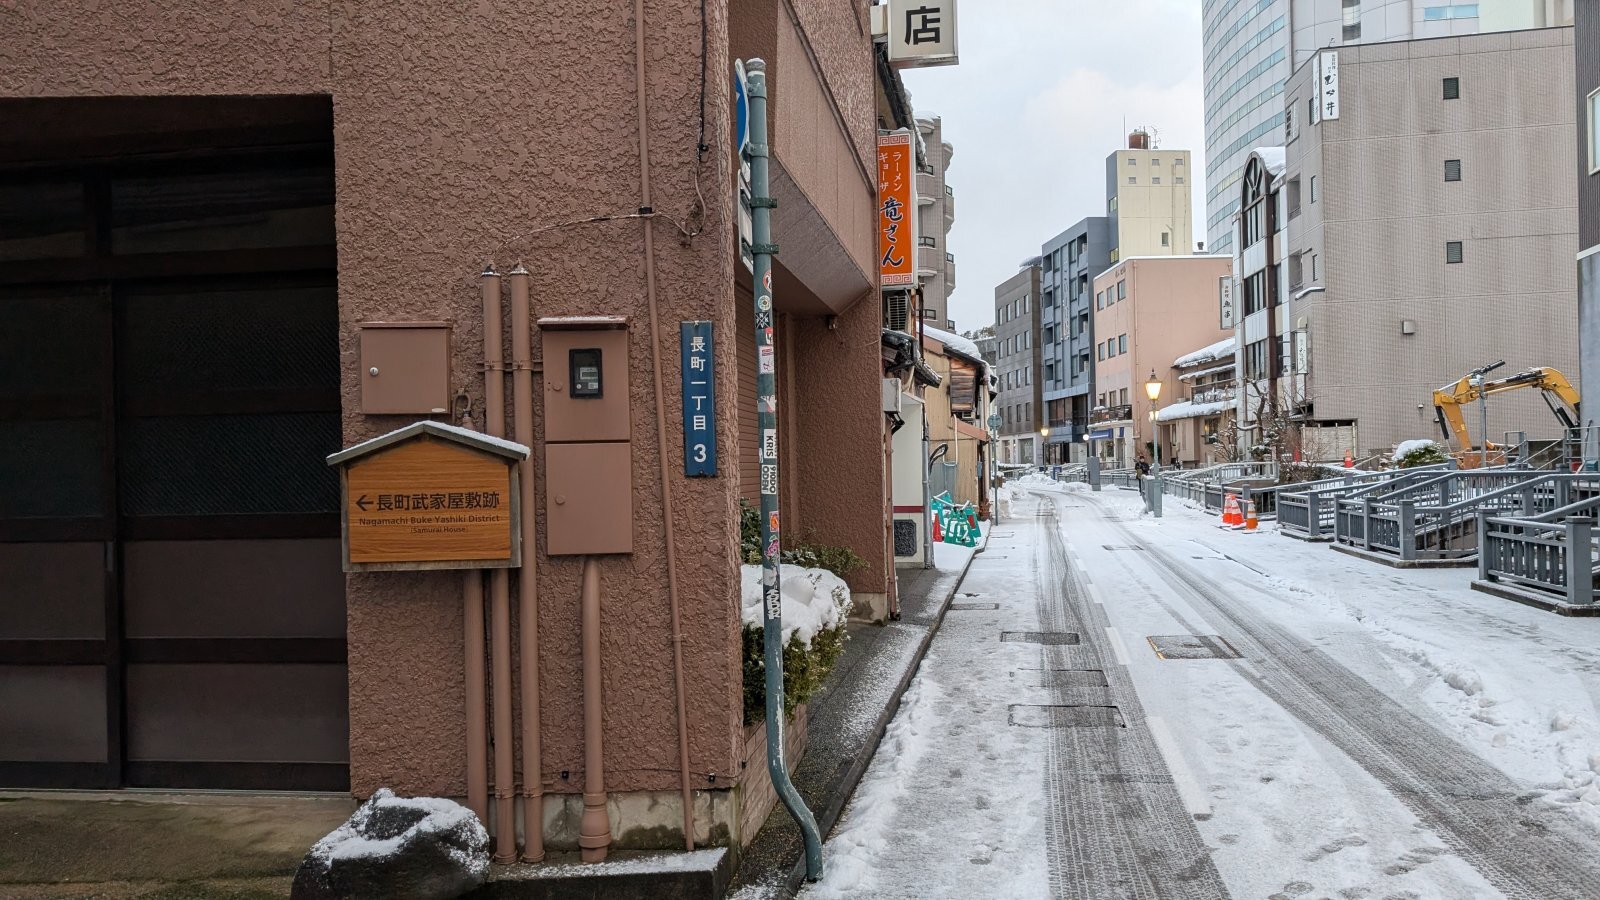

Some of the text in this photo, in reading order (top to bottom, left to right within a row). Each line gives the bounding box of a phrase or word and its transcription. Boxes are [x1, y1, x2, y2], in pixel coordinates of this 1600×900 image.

[904, 6, 940, 45] 店
[879, 152, 889, 192] ギョーザ
[893, 151, 902, 192] ラーメン
[880, 196, 904, 267] 竜さん
[690, 336, 707, 463] 長町一丁目 3
[766, 435, 774, 457] KRIS
[359, 514, 500, 527] Nagamachi Buke Yashiki District
[376, 491, 500, 511] 長町武家屋敷跡
